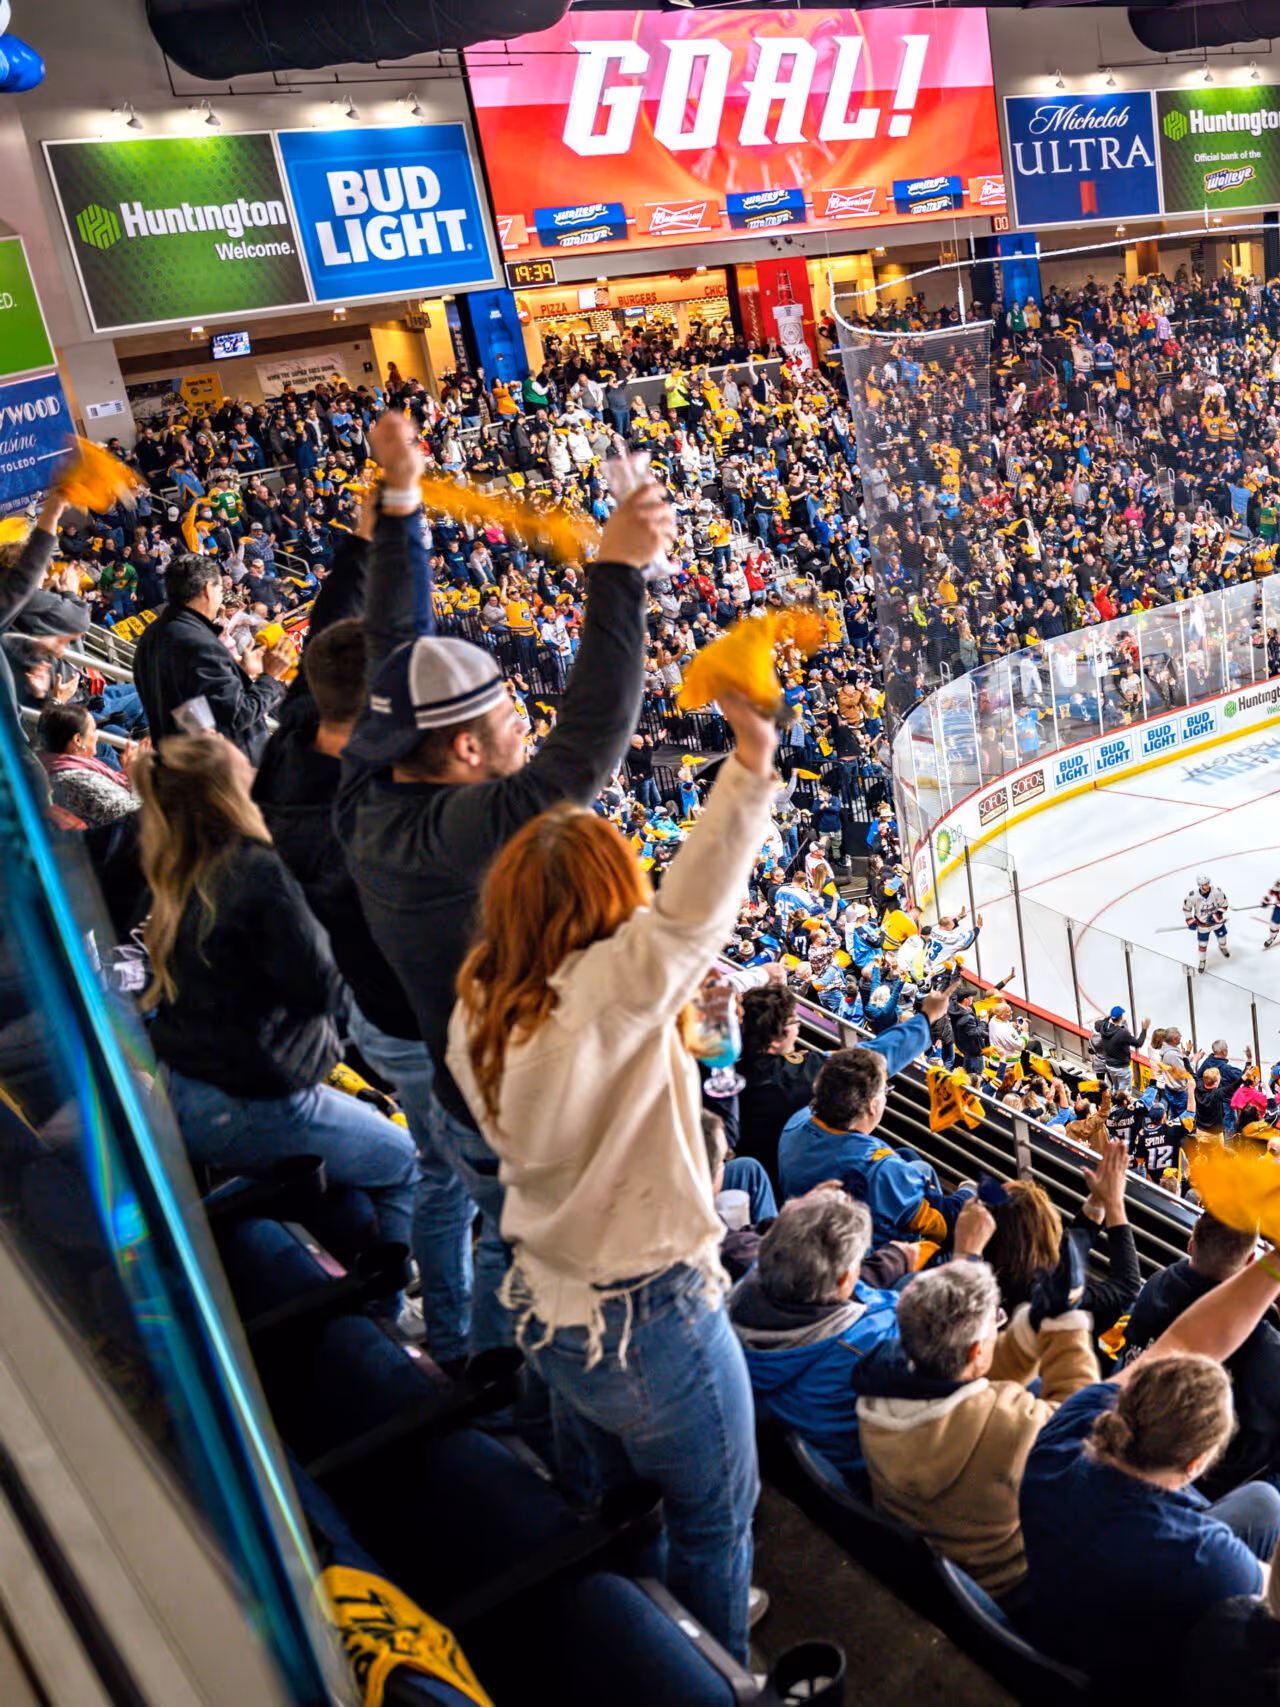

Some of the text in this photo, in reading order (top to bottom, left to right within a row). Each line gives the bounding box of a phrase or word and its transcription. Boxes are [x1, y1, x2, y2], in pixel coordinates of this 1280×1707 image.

[562, 34, 930, 156] GOAL!
[1028, 104, 1131, 135] Michelob
[1012, 134, 1155, 176] ULTRA
[1194, 150, 1261, 162] Official bank of the
[1207, 167, 1253, 190] Walleye
[327, 165, 441, 216] BUD
[120, 198, 288, 241] Huntington
[315, 208, 468, 267] LIGHT
[214, 240, 296, 262] Welcome.
[514, 263, 553, 283] 19:39
[540, 302, 568, 315] PIZZA
[617, 292, 657, 306] BURGERS
[1, 457, 36, 473] TOLEDO
[1183, 719, 1215, 740] LIGHT
[1186, 710, 1210, 728] BUD
[1147, 723, 1172, 741] BUD
[1100, 739, 1126, 756] BUD
[1143, 733, 1176, 754] LIGHT
[1059, 755, 1084, 773] BUD
[1096, 749, 1130, 770] LIGHT
[1055, 764, 1089, 786] LIGHT
[1145, 1135, 1166, 1147] SPINK
[1147, 1145, 1174, 1170] 12
